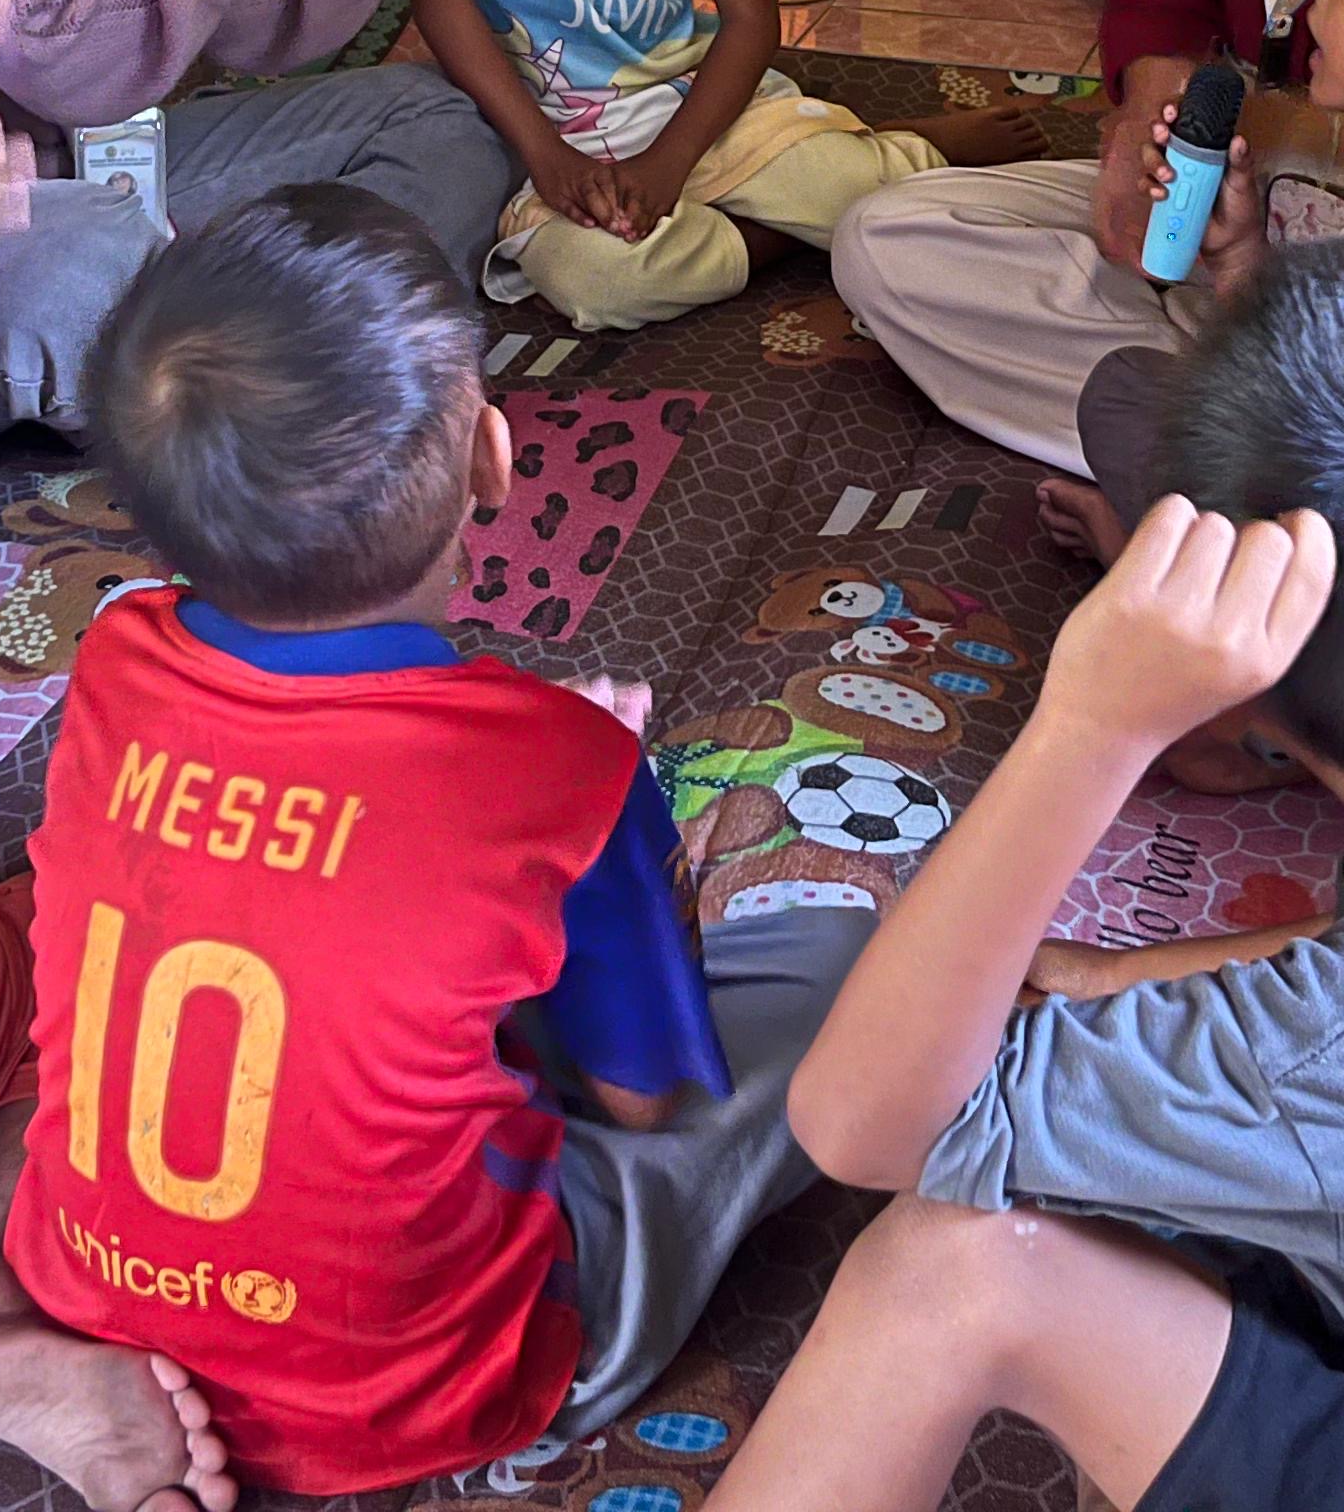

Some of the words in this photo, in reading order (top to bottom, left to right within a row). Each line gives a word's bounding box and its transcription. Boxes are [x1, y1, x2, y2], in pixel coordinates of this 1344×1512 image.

[106, 740, 365, 878] MESSI
[1112, 823, 1200, 898] bear
[68, 900, 288, 1223] 10
[58, 1208, 214, 1310] unicef
